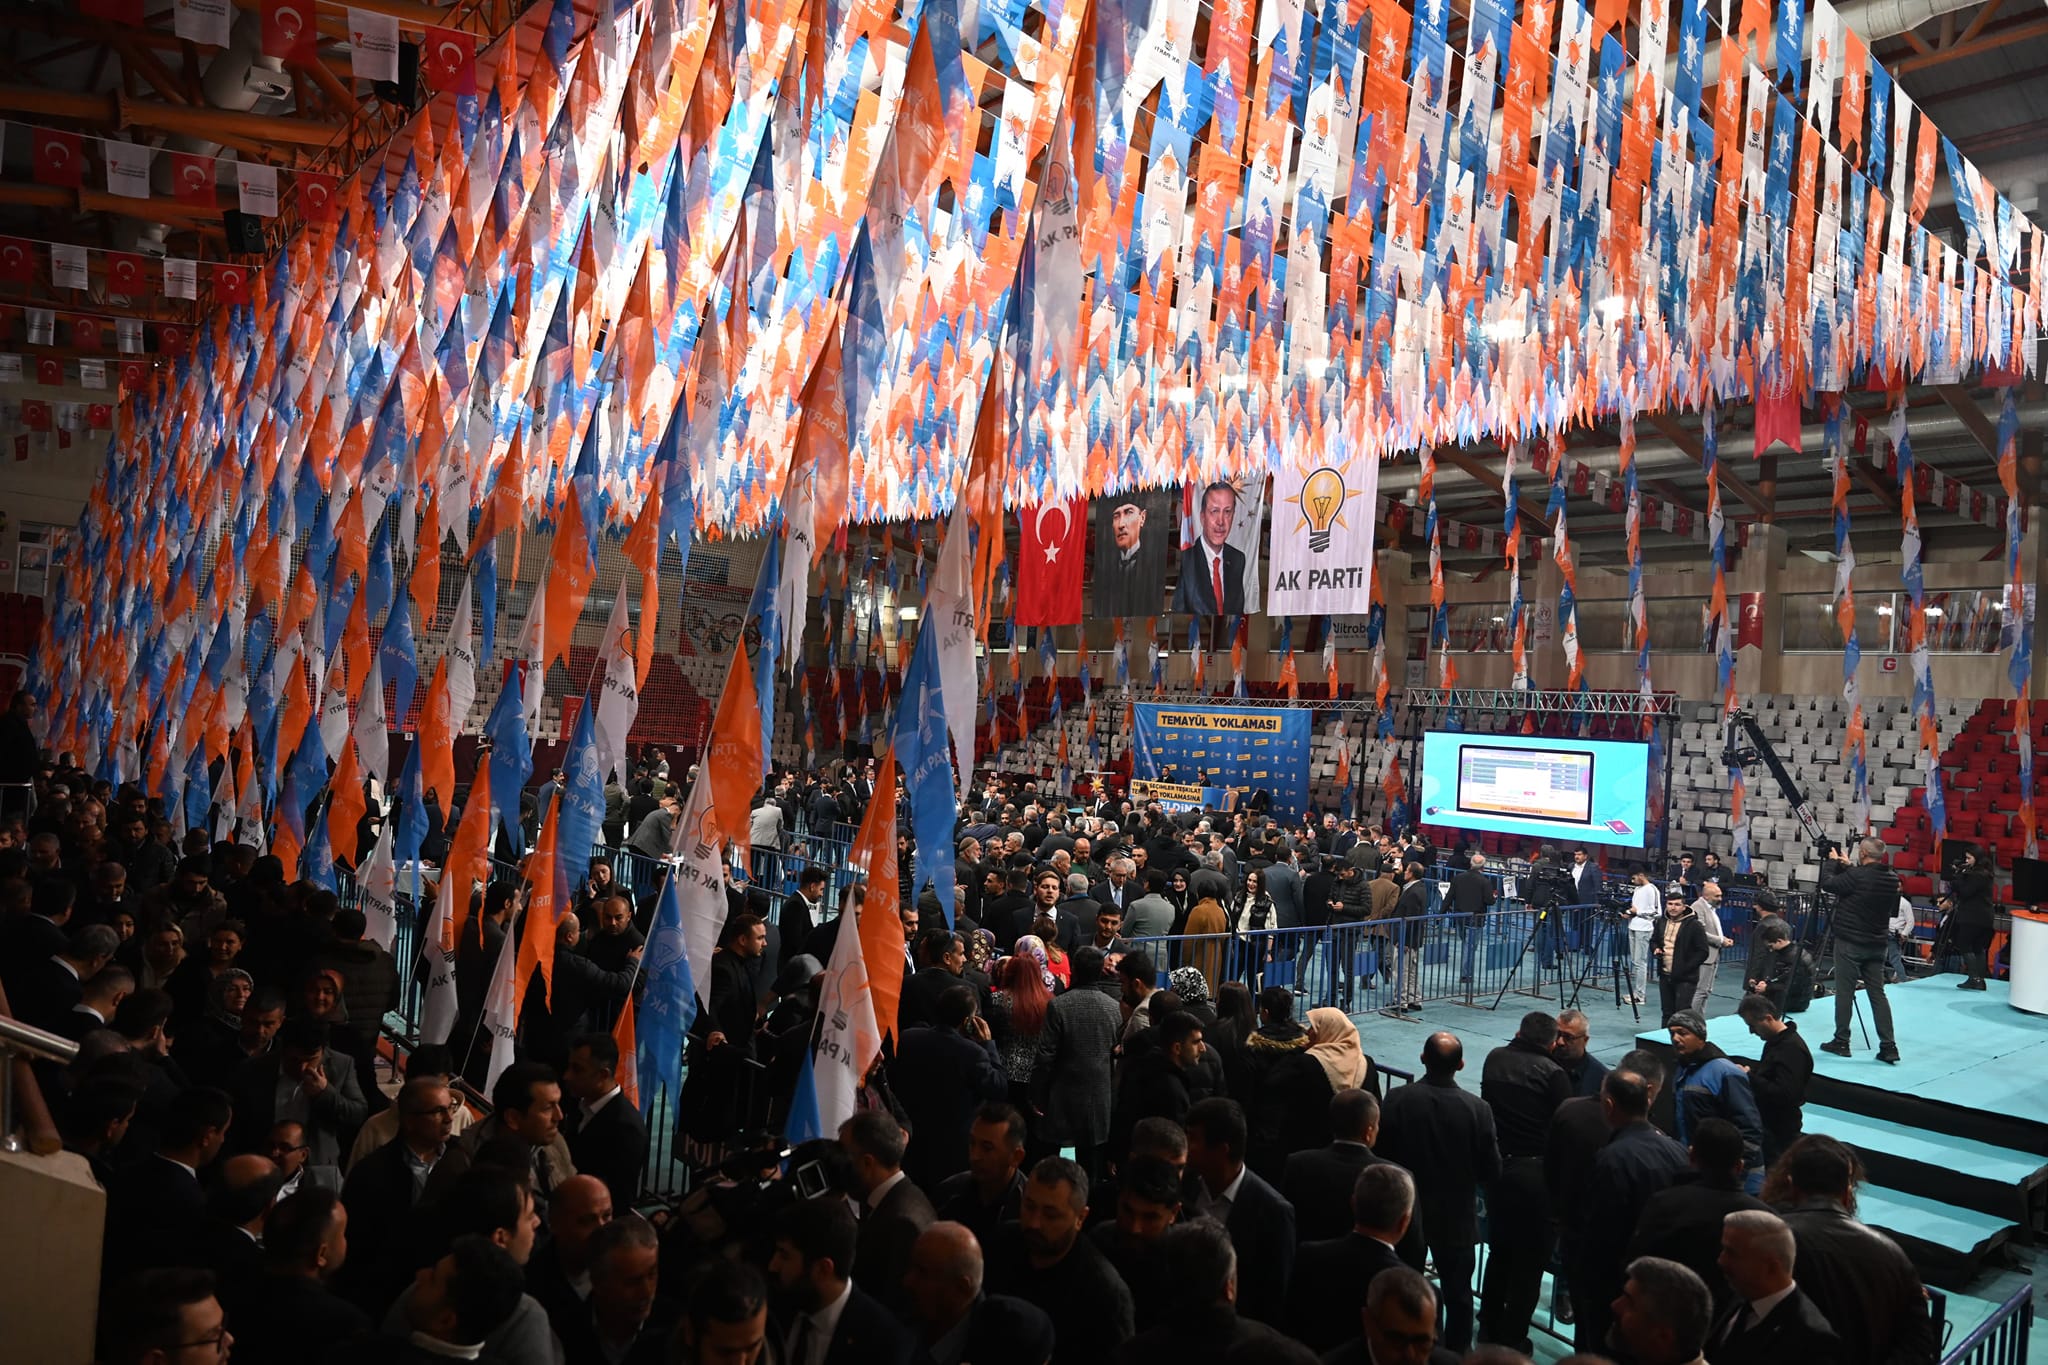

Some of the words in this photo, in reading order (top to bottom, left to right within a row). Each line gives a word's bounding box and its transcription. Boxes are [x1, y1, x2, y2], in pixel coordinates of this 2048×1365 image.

[1275, 570, 1302, 591] AK
[1883, 657, 1896, 670] G
[1161, 714, 1208, 727] TEMAYÜL
[1213, 717, 1277, 730] YOKLAMASI
